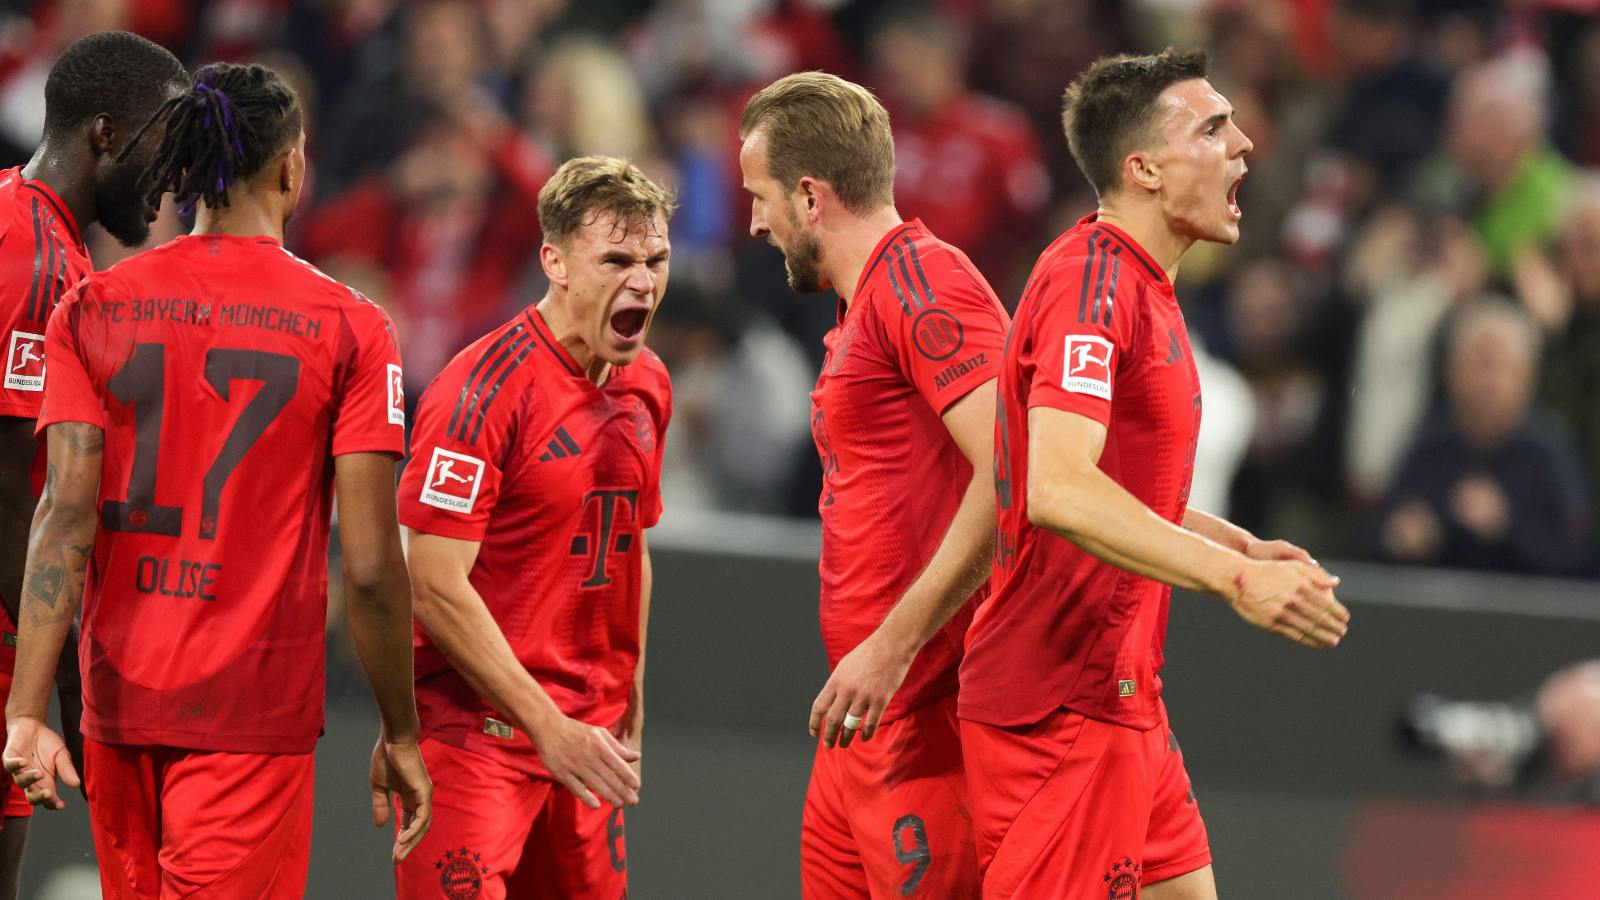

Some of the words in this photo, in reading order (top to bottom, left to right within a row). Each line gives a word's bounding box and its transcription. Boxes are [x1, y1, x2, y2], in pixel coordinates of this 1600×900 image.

[100, 301, 126, 323] FC
[131, 299, 212, 326] BAYERN
[219, 303, 321, 339] MÜNCHEN
[934, 353, 988, 391] Allianz
[101, 343, 300, 540] 17
[425, 492, 468, 508] BUNDESLIGA
[135, 555, 223, 601] OLISE
[892, 812, 932, 896] 9
